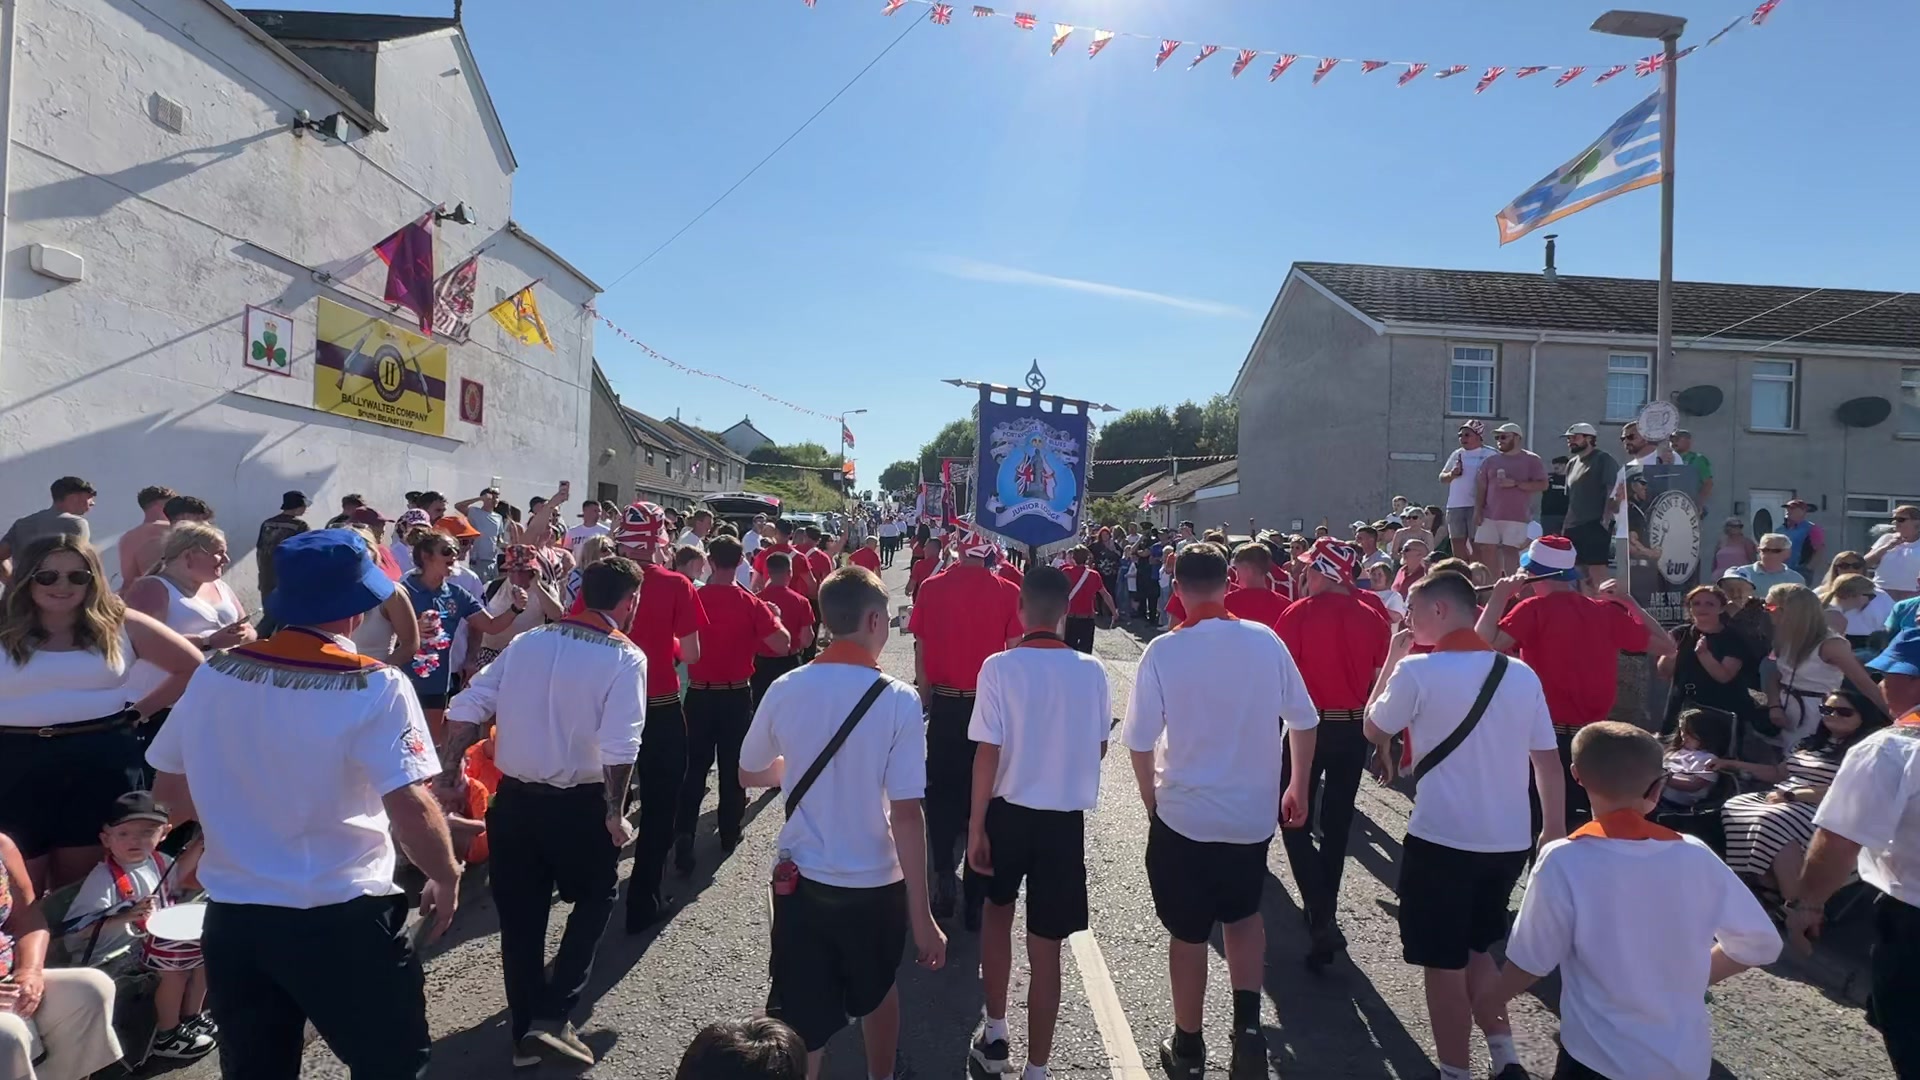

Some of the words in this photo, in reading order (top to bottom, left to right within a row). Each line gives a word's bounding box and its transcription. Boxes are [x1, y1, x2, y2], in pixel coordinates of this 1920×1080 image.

[341, 393, 395, 414] BALLYWALTER
[396, 407, 428, 422] COMPANY
[1012, 502, 1040, 518] JUNIOR
[1040, 504, 1061, 521] LODGE
[1650, 592, 1666, 607] ARE
[1666, 591, 1681, 606] YOU
